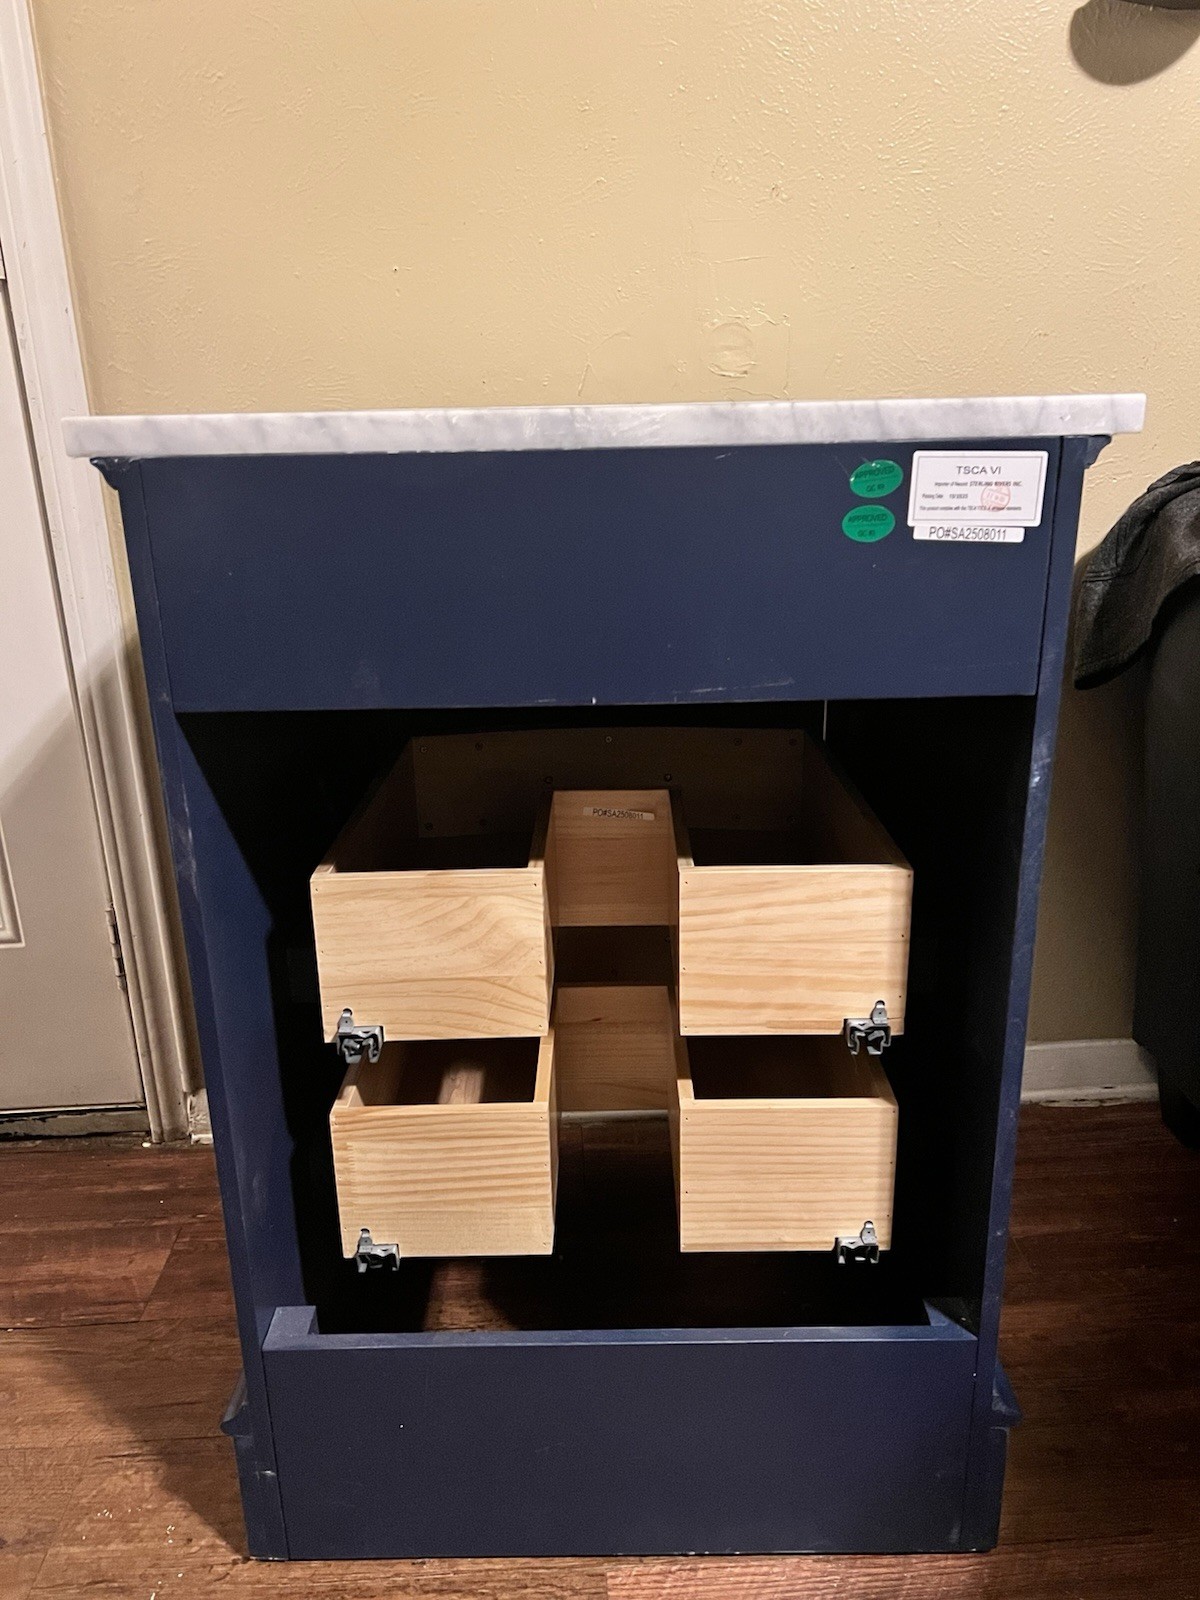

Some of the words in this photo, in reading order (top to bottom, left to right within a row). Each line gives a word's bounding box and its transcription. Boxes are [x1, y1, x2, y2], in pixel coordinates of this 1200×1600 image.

[956, 465, 987, 475] TSCA
[990, 465, 1002, 475] VI
[928, 526, 1007, 541] PO#SA2508011
[592, 808, 643, 820] PO#SA2508011
